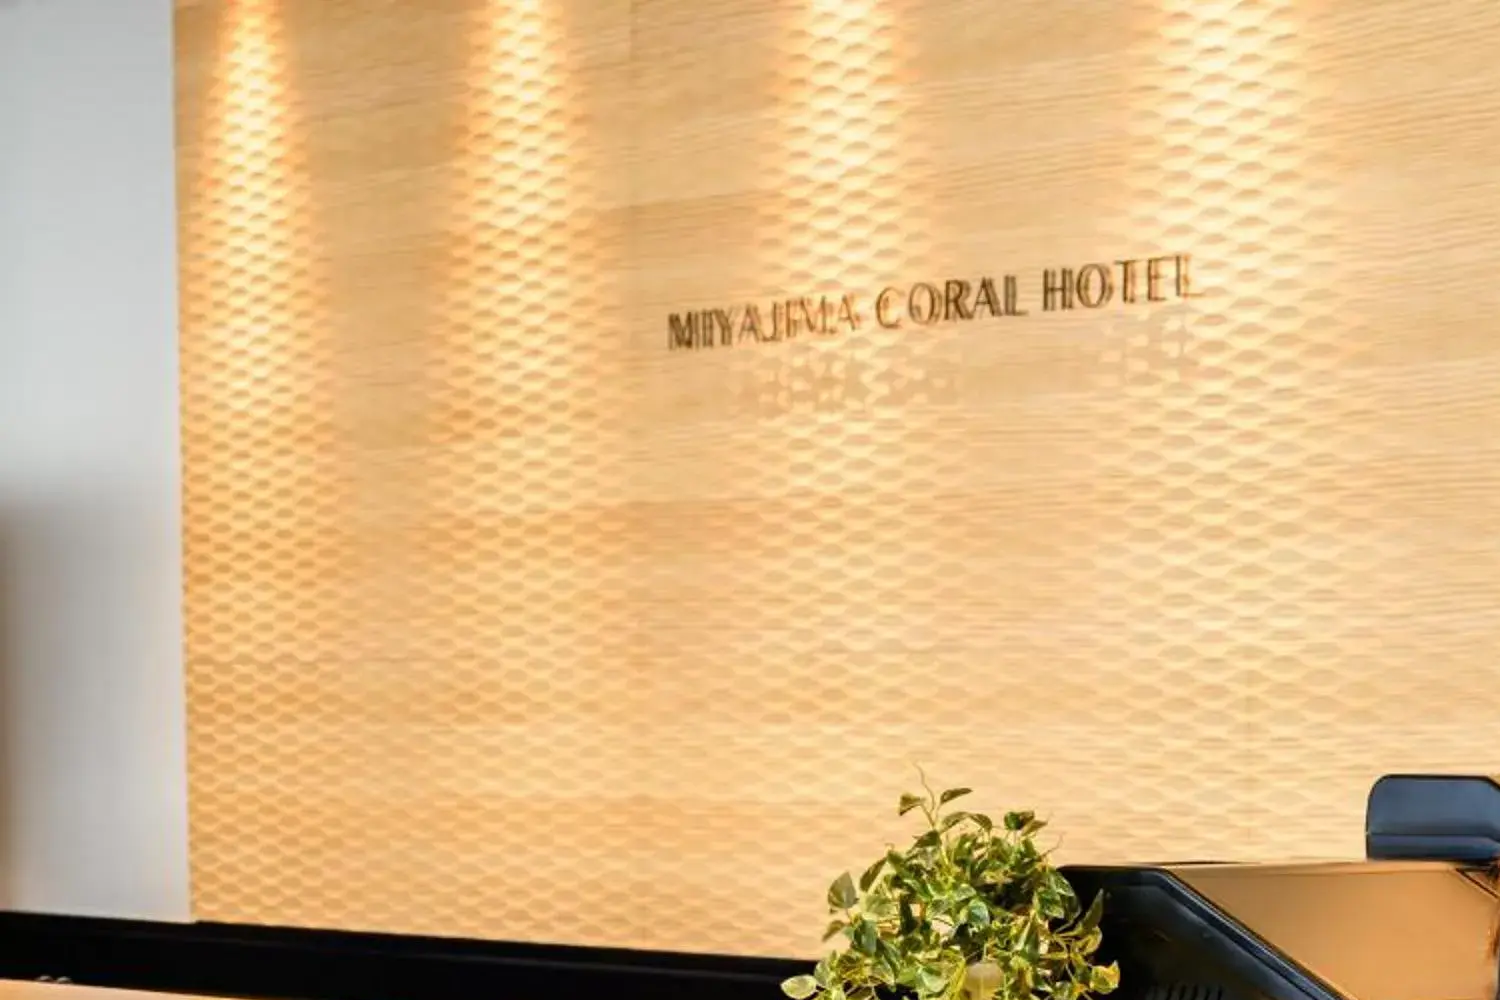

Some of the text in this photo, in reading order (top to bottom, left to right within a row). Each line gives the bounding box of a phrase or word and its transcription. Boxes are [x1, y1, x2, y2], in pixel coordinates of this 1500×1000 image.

[668, 253, 1206, 350] MIYAJIMA CORAL HOTEL
